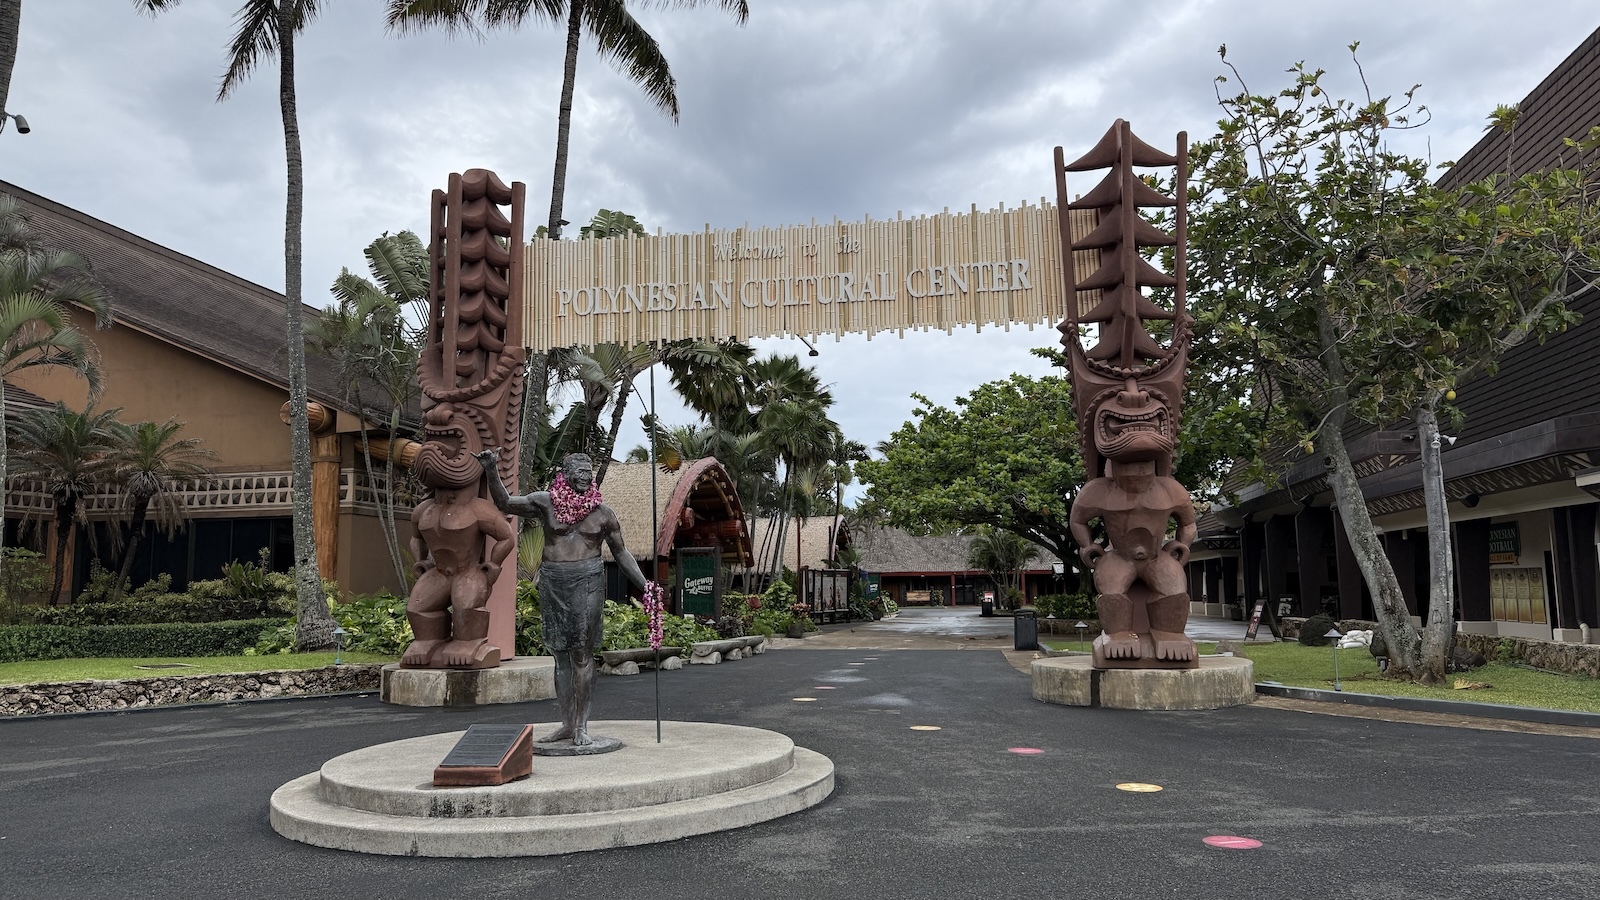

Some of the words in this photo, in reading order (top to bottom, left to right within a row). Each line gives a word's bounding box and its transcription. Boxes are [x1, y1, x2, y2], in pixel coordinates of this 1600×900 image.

[713, 240, 785, 262] Welcome
[802, 243, 818, 257] to
[836, 234, 861, 254] the
[556, 279, 734, 317] POLYNESIAN
[740, 271, 897, 308] CULTURAL
[906, 258, 1033, 298] CENTER
[1489, 528, 1516, 541] YNESIAN
[684, 576, 714, 588] Gateway
